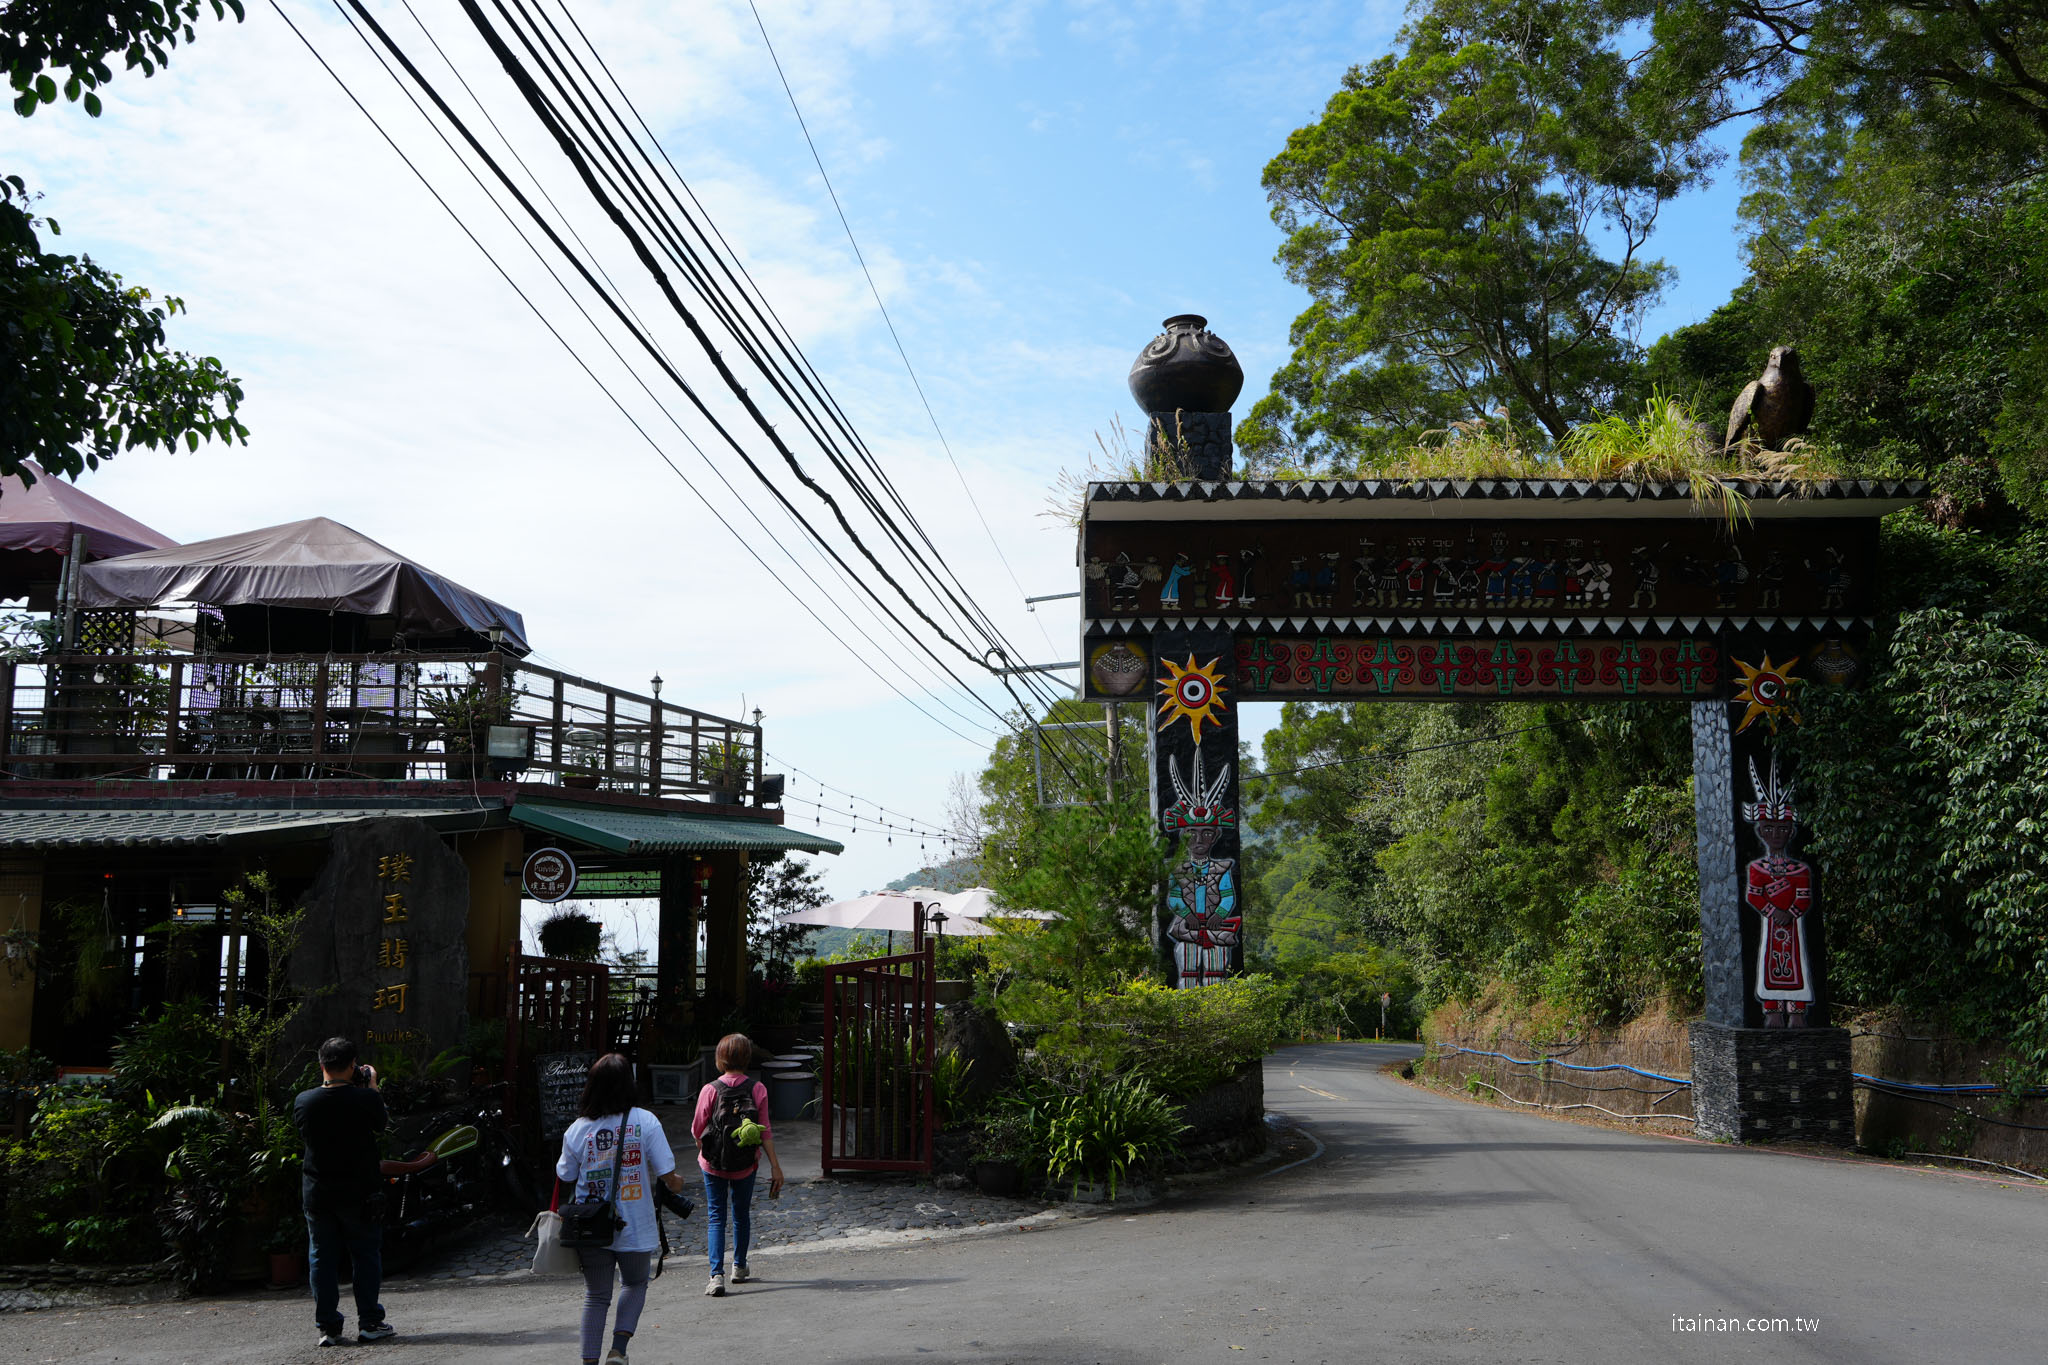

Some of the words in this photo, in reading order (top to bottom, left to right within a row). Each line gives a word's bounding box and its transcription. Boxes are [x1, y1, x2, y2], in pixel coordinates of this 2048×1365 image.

[535, 864, 560, 873] Puivike
[372, 851, 416, 1015] 璞玉翡珂
